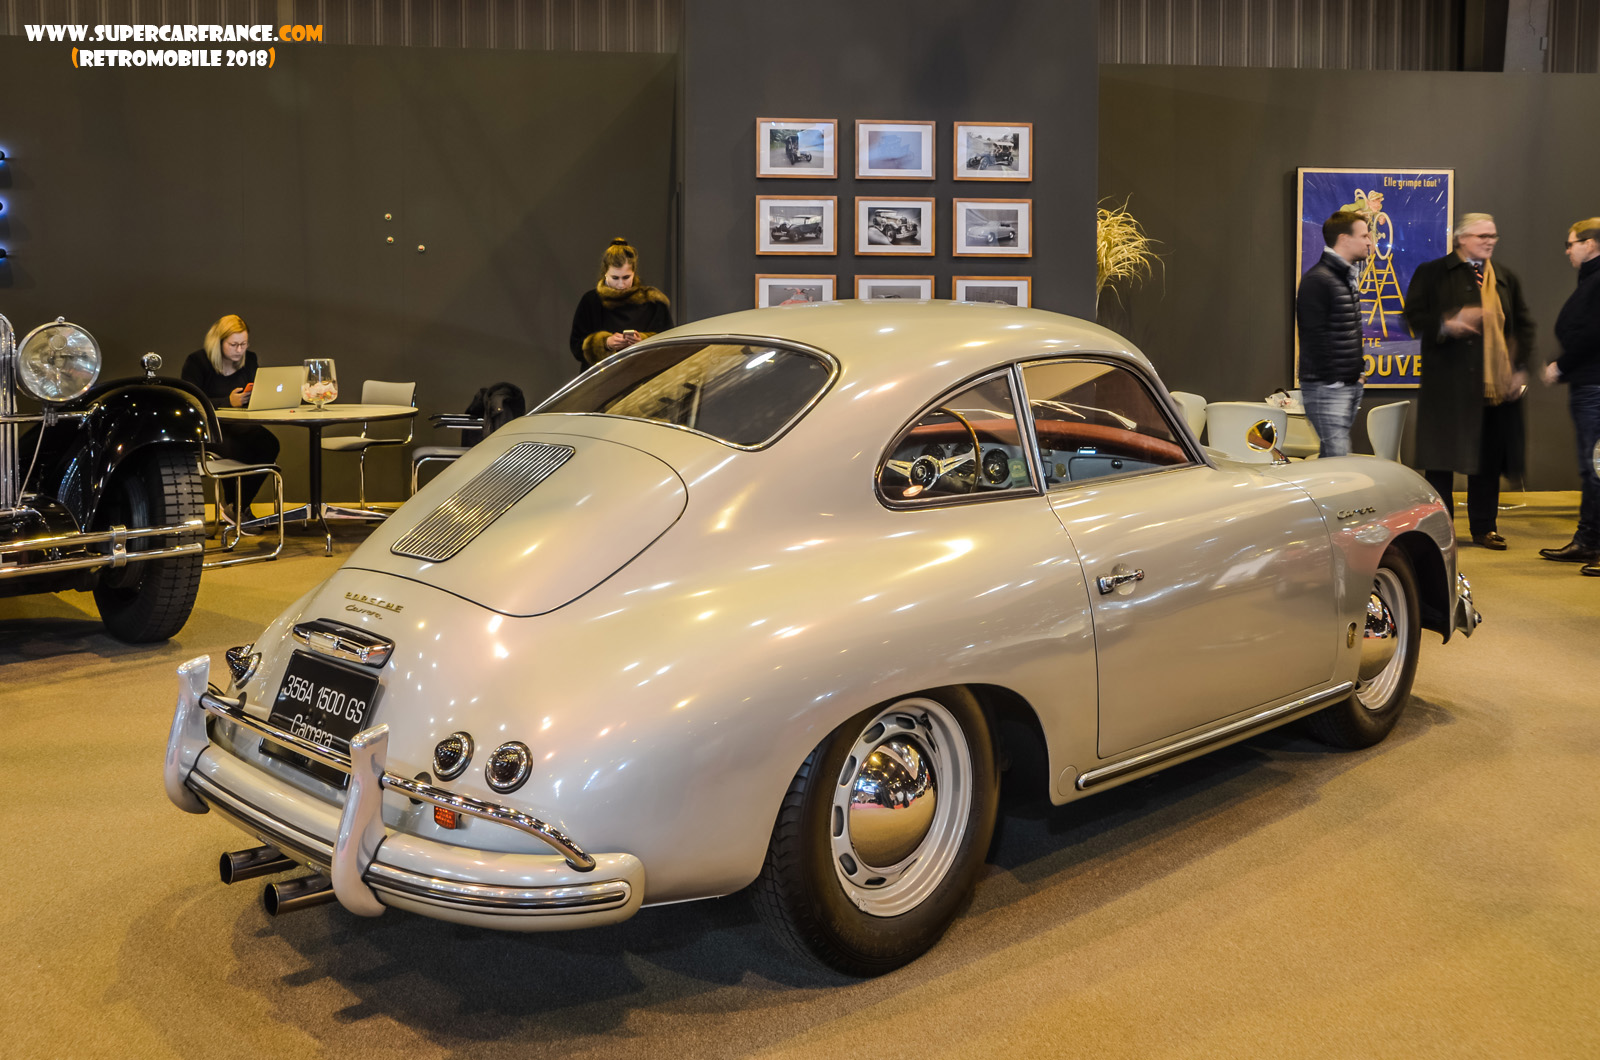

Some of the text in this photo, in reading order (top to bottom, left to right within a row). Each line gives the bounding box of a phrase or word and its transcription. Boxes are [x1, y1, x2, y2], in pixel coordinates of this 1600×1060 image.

[1383, 176, 1397, 187] Elle
[1398, 180, 1422, 190] grimpe
[344, 591, 404, 613] PORSCHE
[283, 674, 366, 724] 356A 1500 GS
[290, 713, 333, 747] Carrera
